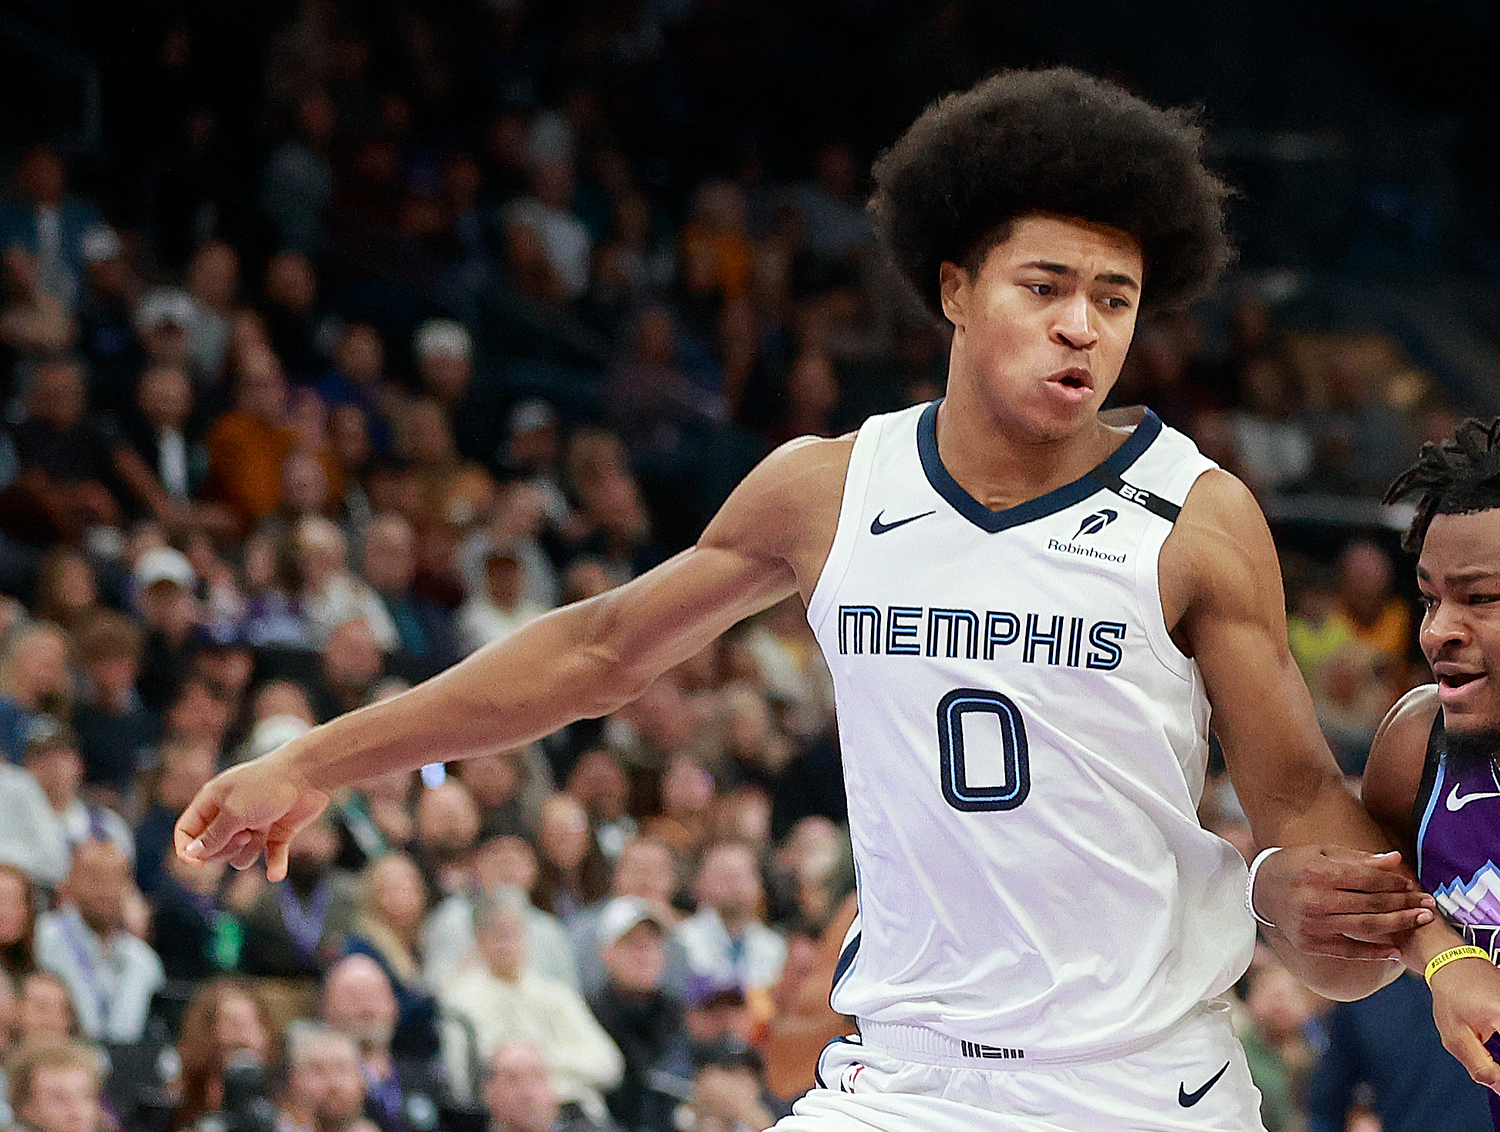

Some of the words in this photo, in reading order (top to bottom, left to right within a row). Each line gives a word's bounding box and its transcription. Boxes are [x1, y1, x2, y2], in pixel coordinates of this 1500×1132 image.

[1118, 483, 1150, 506] BC
[1047, 538, 1127, 564] Robinhood
[838, 604, 1127, 671] MEMPHIS
[937, 688, 1031, 812] 0
